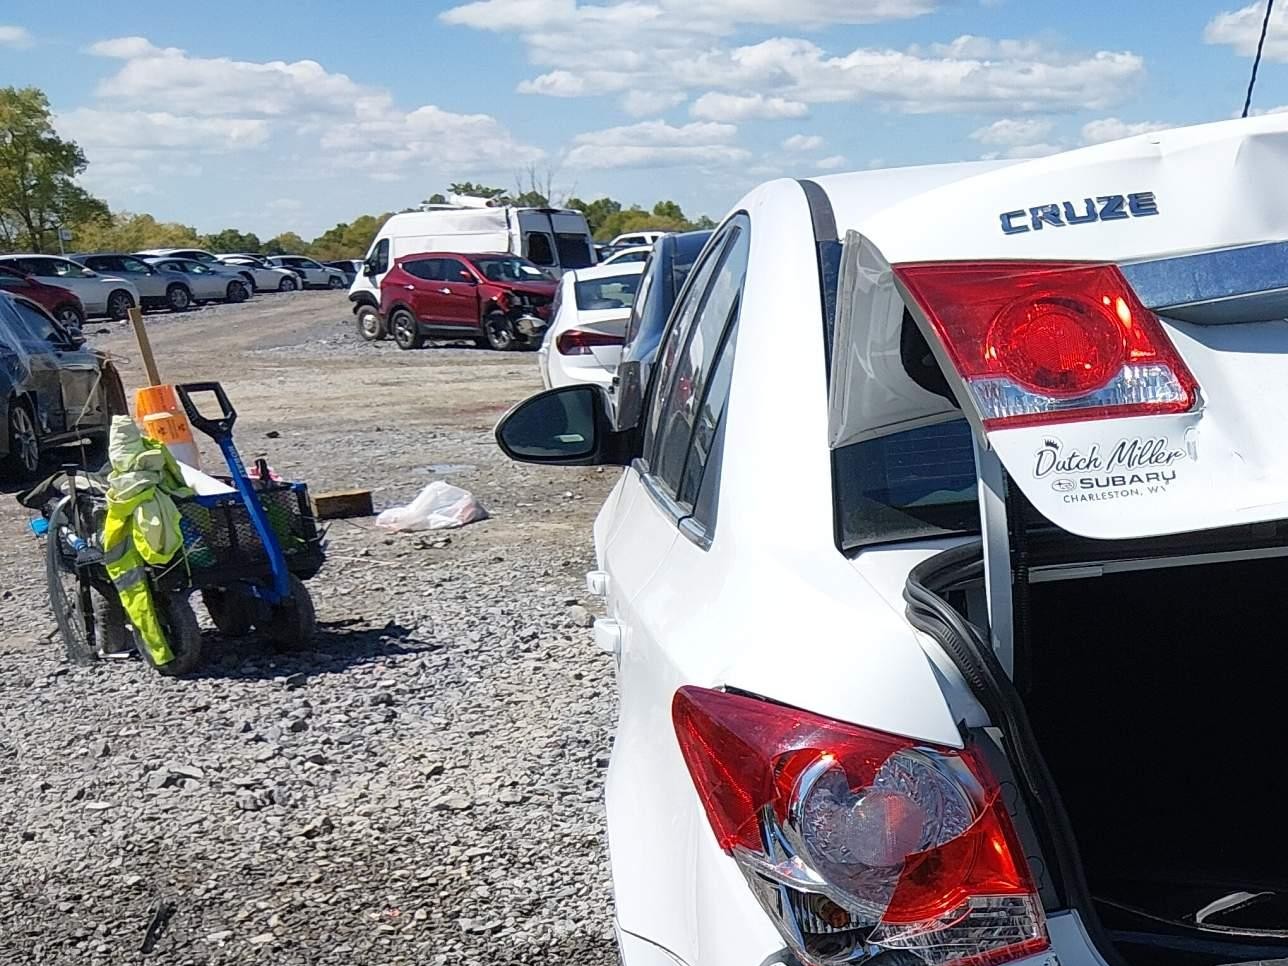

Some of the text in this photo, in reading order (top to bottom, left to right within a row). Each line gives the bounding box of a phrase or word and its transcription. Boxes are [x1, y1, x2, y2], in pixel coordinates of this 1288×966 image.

[999, 191, 1159, 236] CRUZE
[1035, 438, 1186, 477] Dutch Miller
[1063, 488, 1144, 503] CHARLESTON,
